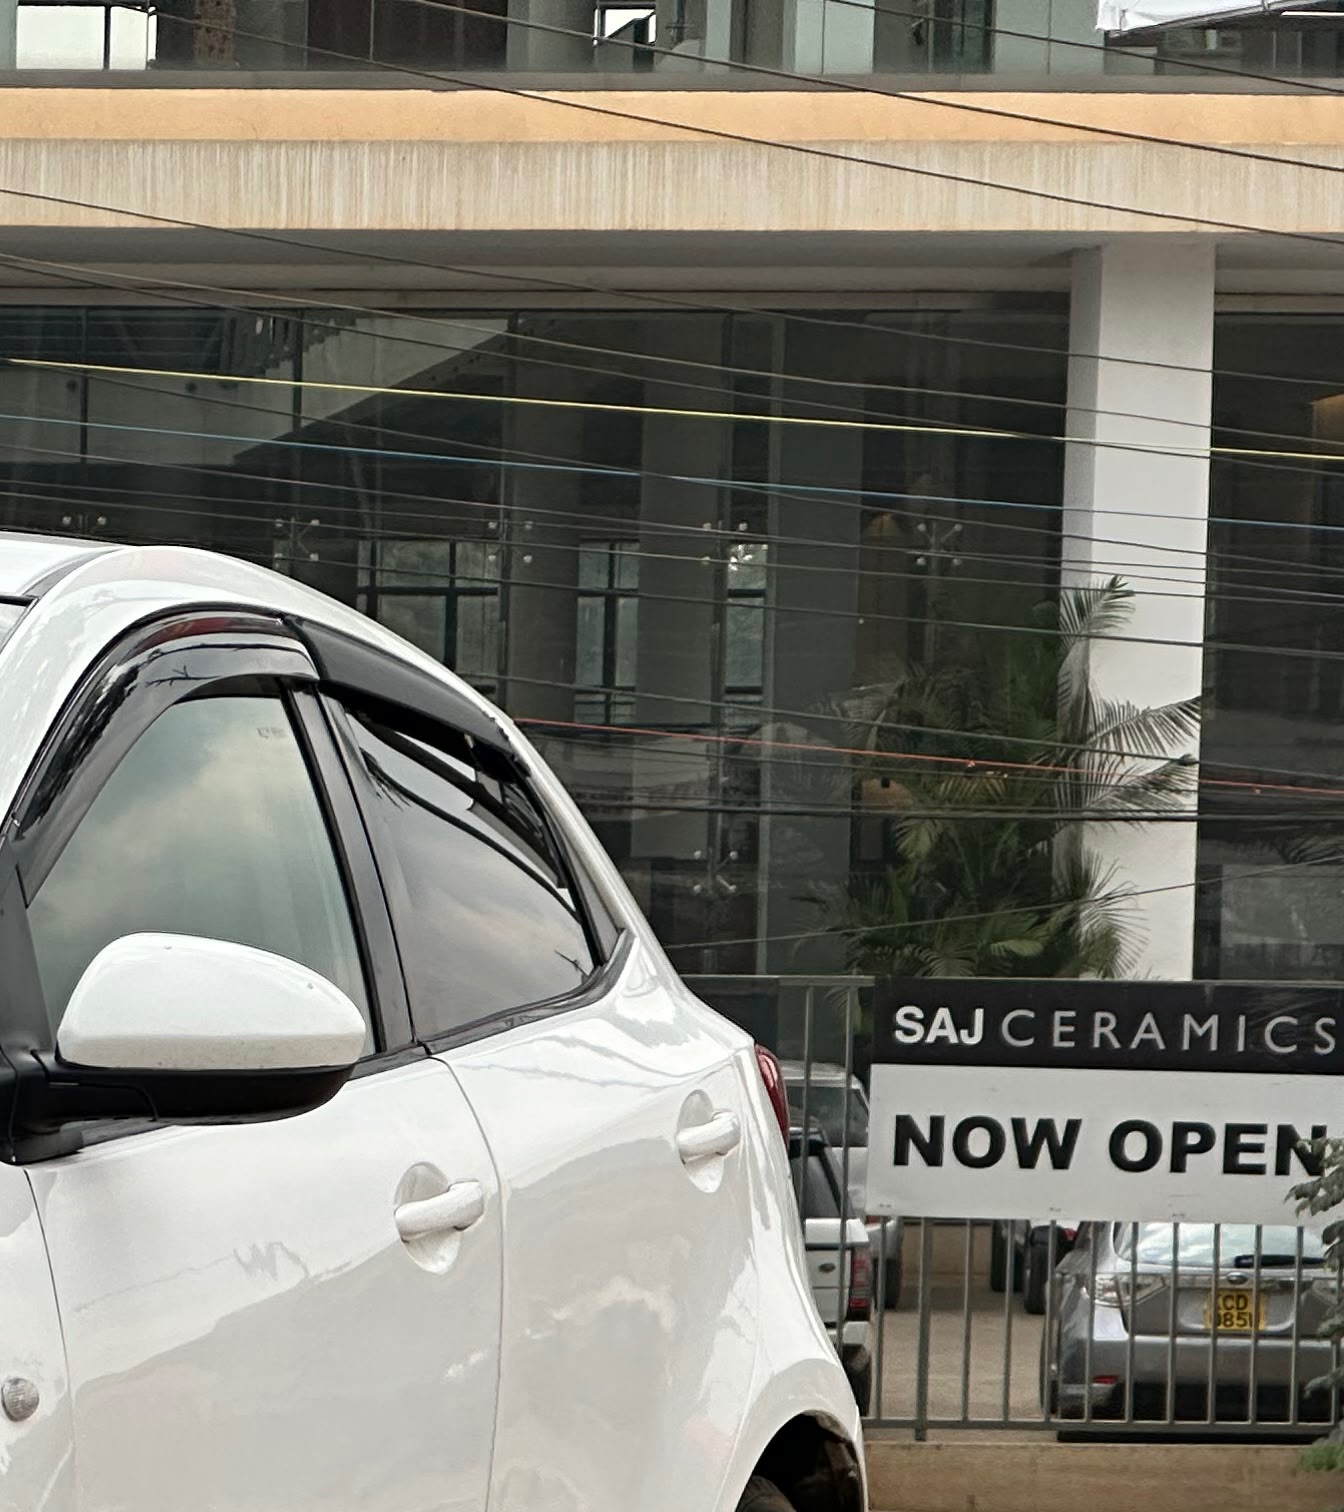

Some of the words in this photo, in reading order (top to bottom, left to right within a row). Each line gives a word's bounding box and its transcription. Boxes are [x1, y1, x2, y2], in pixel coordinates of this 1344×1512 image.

[894, 1005, 984, 1044] SAJ
[1001, 1009, 1336, 1055] CERAMICS
[893, 1114, 1082, 1170] NOW
[1108, 1119, 1327, 1177] OPEN
